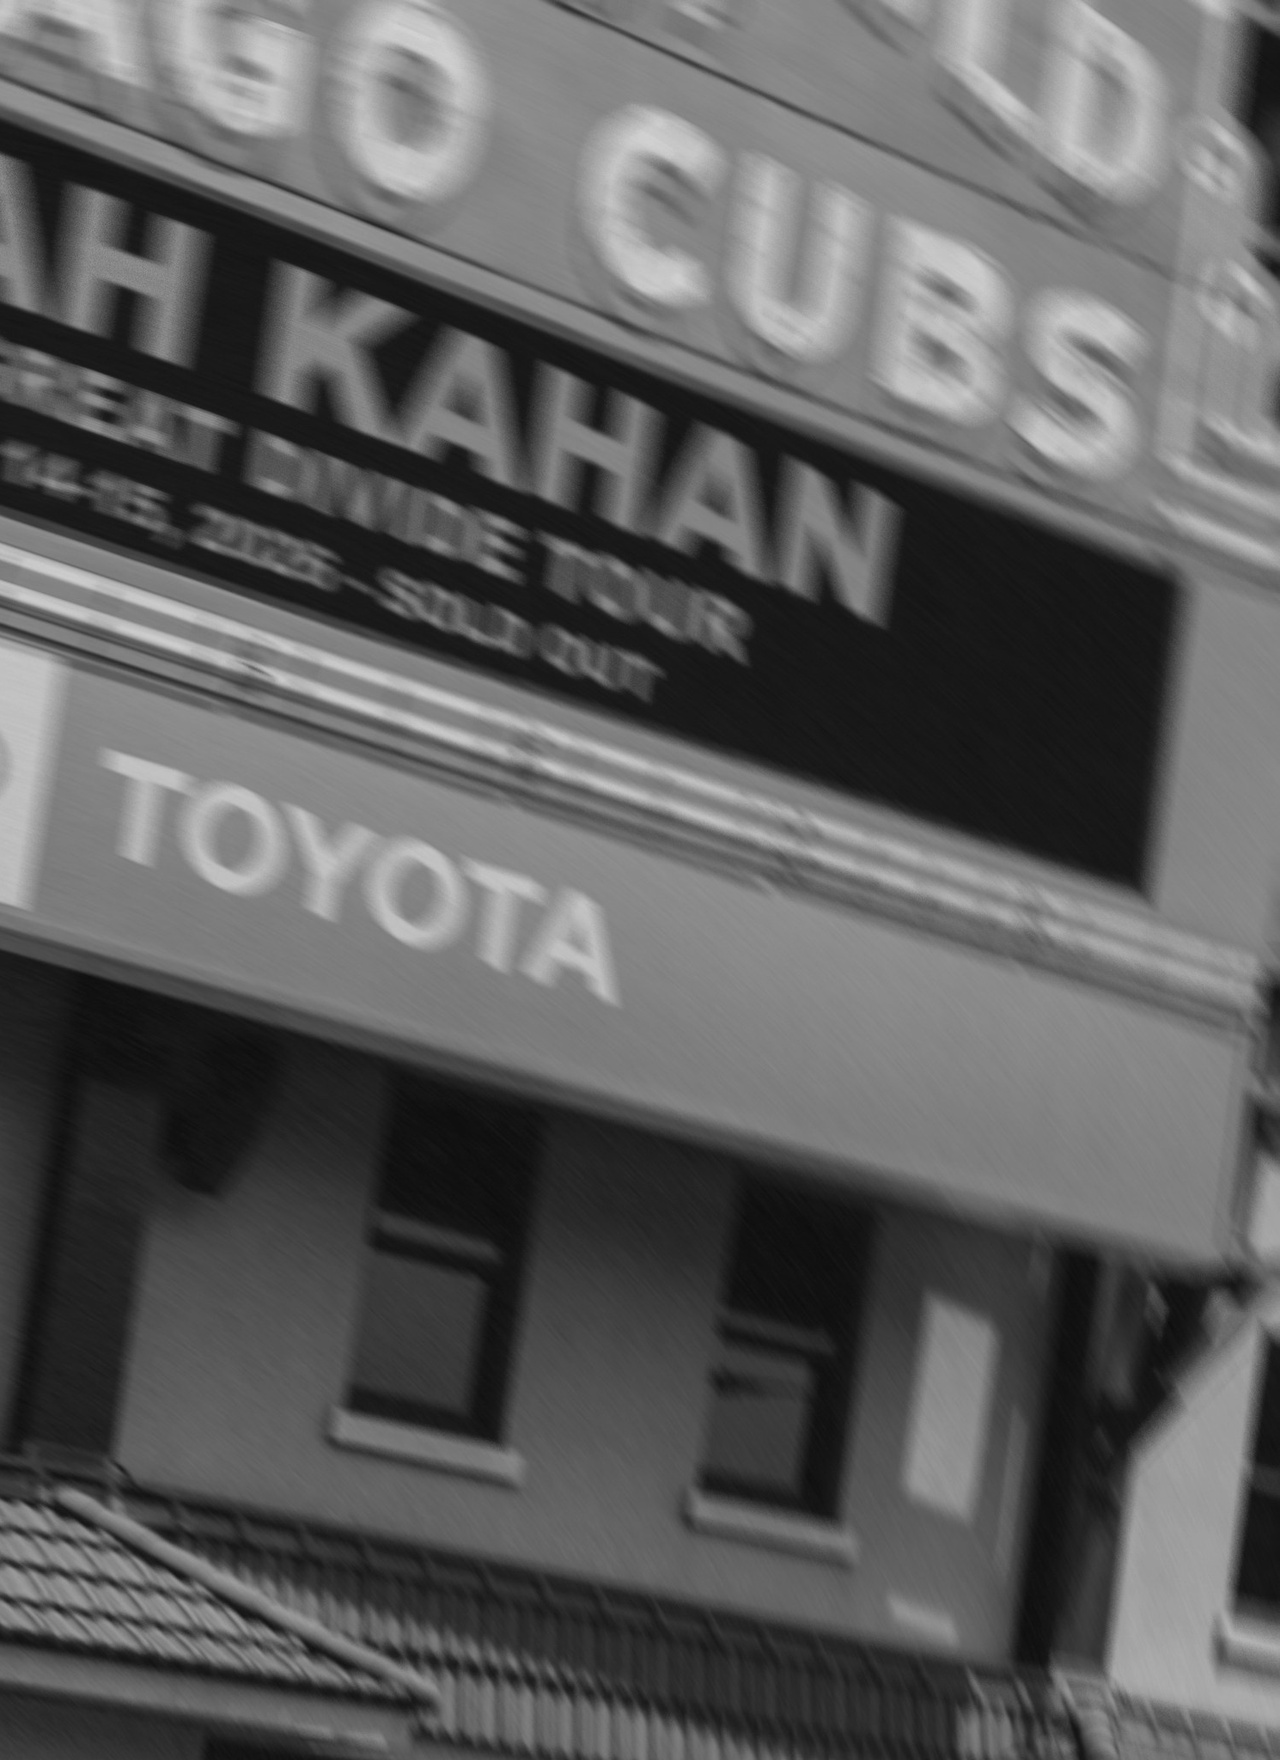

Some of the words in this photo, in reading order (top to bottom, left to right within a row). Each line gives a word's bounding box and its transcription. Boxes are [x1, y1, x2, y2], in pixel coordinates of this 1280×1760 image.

[255, 260, 906, 632] KAHAN
[577, 104, 1153, 478] CUBS
[242, 428, 531, 585] DIVIDE
[534, 530, 754, 666] TOUR
[101, 747, 621, 1007] TOYOTA
